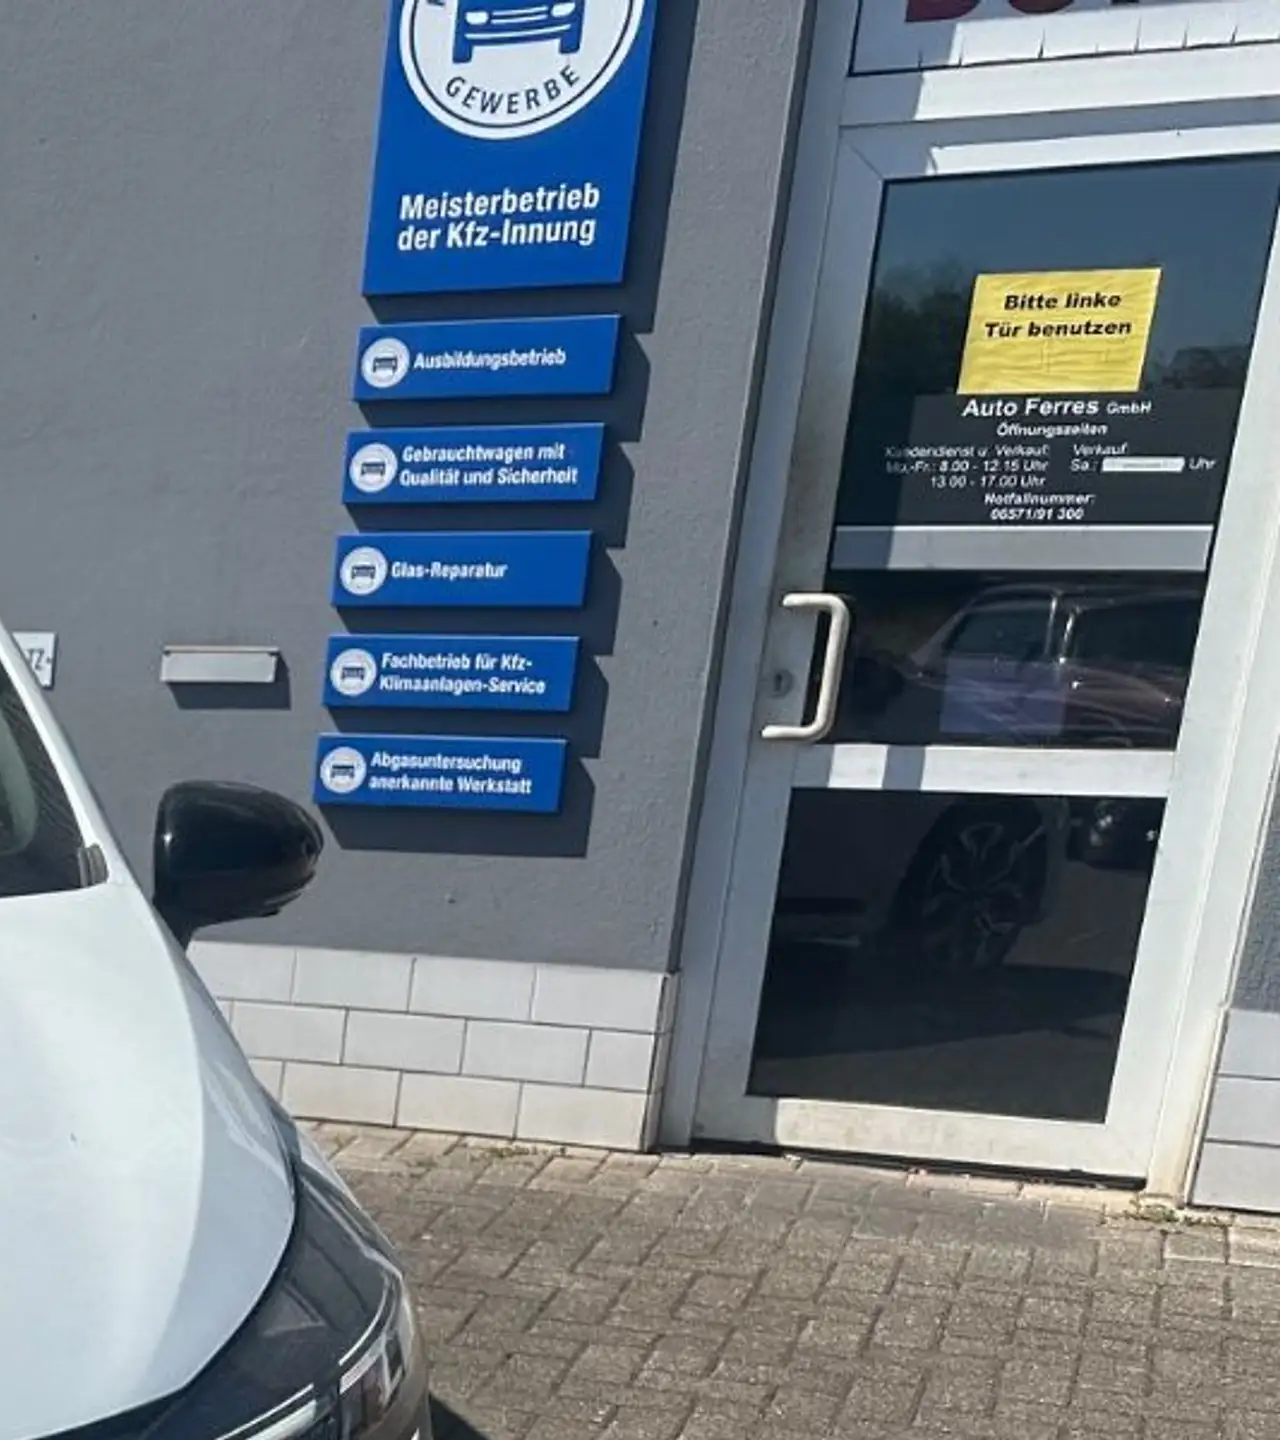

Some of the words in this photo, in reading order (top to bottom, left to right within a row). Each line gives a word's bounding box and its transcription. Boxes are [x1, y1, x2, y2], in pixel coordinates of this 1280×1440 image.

[444, 64, 581, 115] GEWERBE
[400, 183, 600, 220] Meisterbetrieb
[398, 226, 440, 251] der
[446, 218, 596, 248] Kfz-Innung
[1004, 294, 1058, 310] Bitte
[1064, 292, 1122, 309] linke
[985, 321, 1023, 337] Tür
[1028, 321, 1132, 337] benutzen
[413, 347, 566, 371] Ausbildungsbetrieb
[961, 398, 1018, 417] Auto
[1024, 397, 1099, 416] Ferres
[1106, 402, 1153, 414] GmbH
[996, 421, 1108, 438] Öffnungszeiten
[402, 444, 534, 465] Gebrauchtwagen
[537, 443, 566, 461] mit
[1189, 456, 1216, 470] Uhr
[984, 460, 1019, 472] 12.15
[1023, 460, 1049, 472] Uhr
[400, 467, 459, 487] Qualität
[463, 468, 493, 485] und
[497, 466, 578, 485] Sicherheit
[981, 475, 1018, 488] 17.00
[1021, 475, 1046, 487] Uhr
[990, 508, 1052, 520] 06571/91
[391, 561, 508, 581] Glas-Reparatur
[381, 652, 471, 670] Fachbetrieb
[475, 652, 498, 671] für
[500, 654, 532, 671] Kfz-
[379, 675, 545, 695] Klimaanlagen-Service
[371, 751, 522, 774] Abgasuntersuchung
[369, 775, 454, 792] anerkannte
[457, 776, 532, 794] Werkstatt
